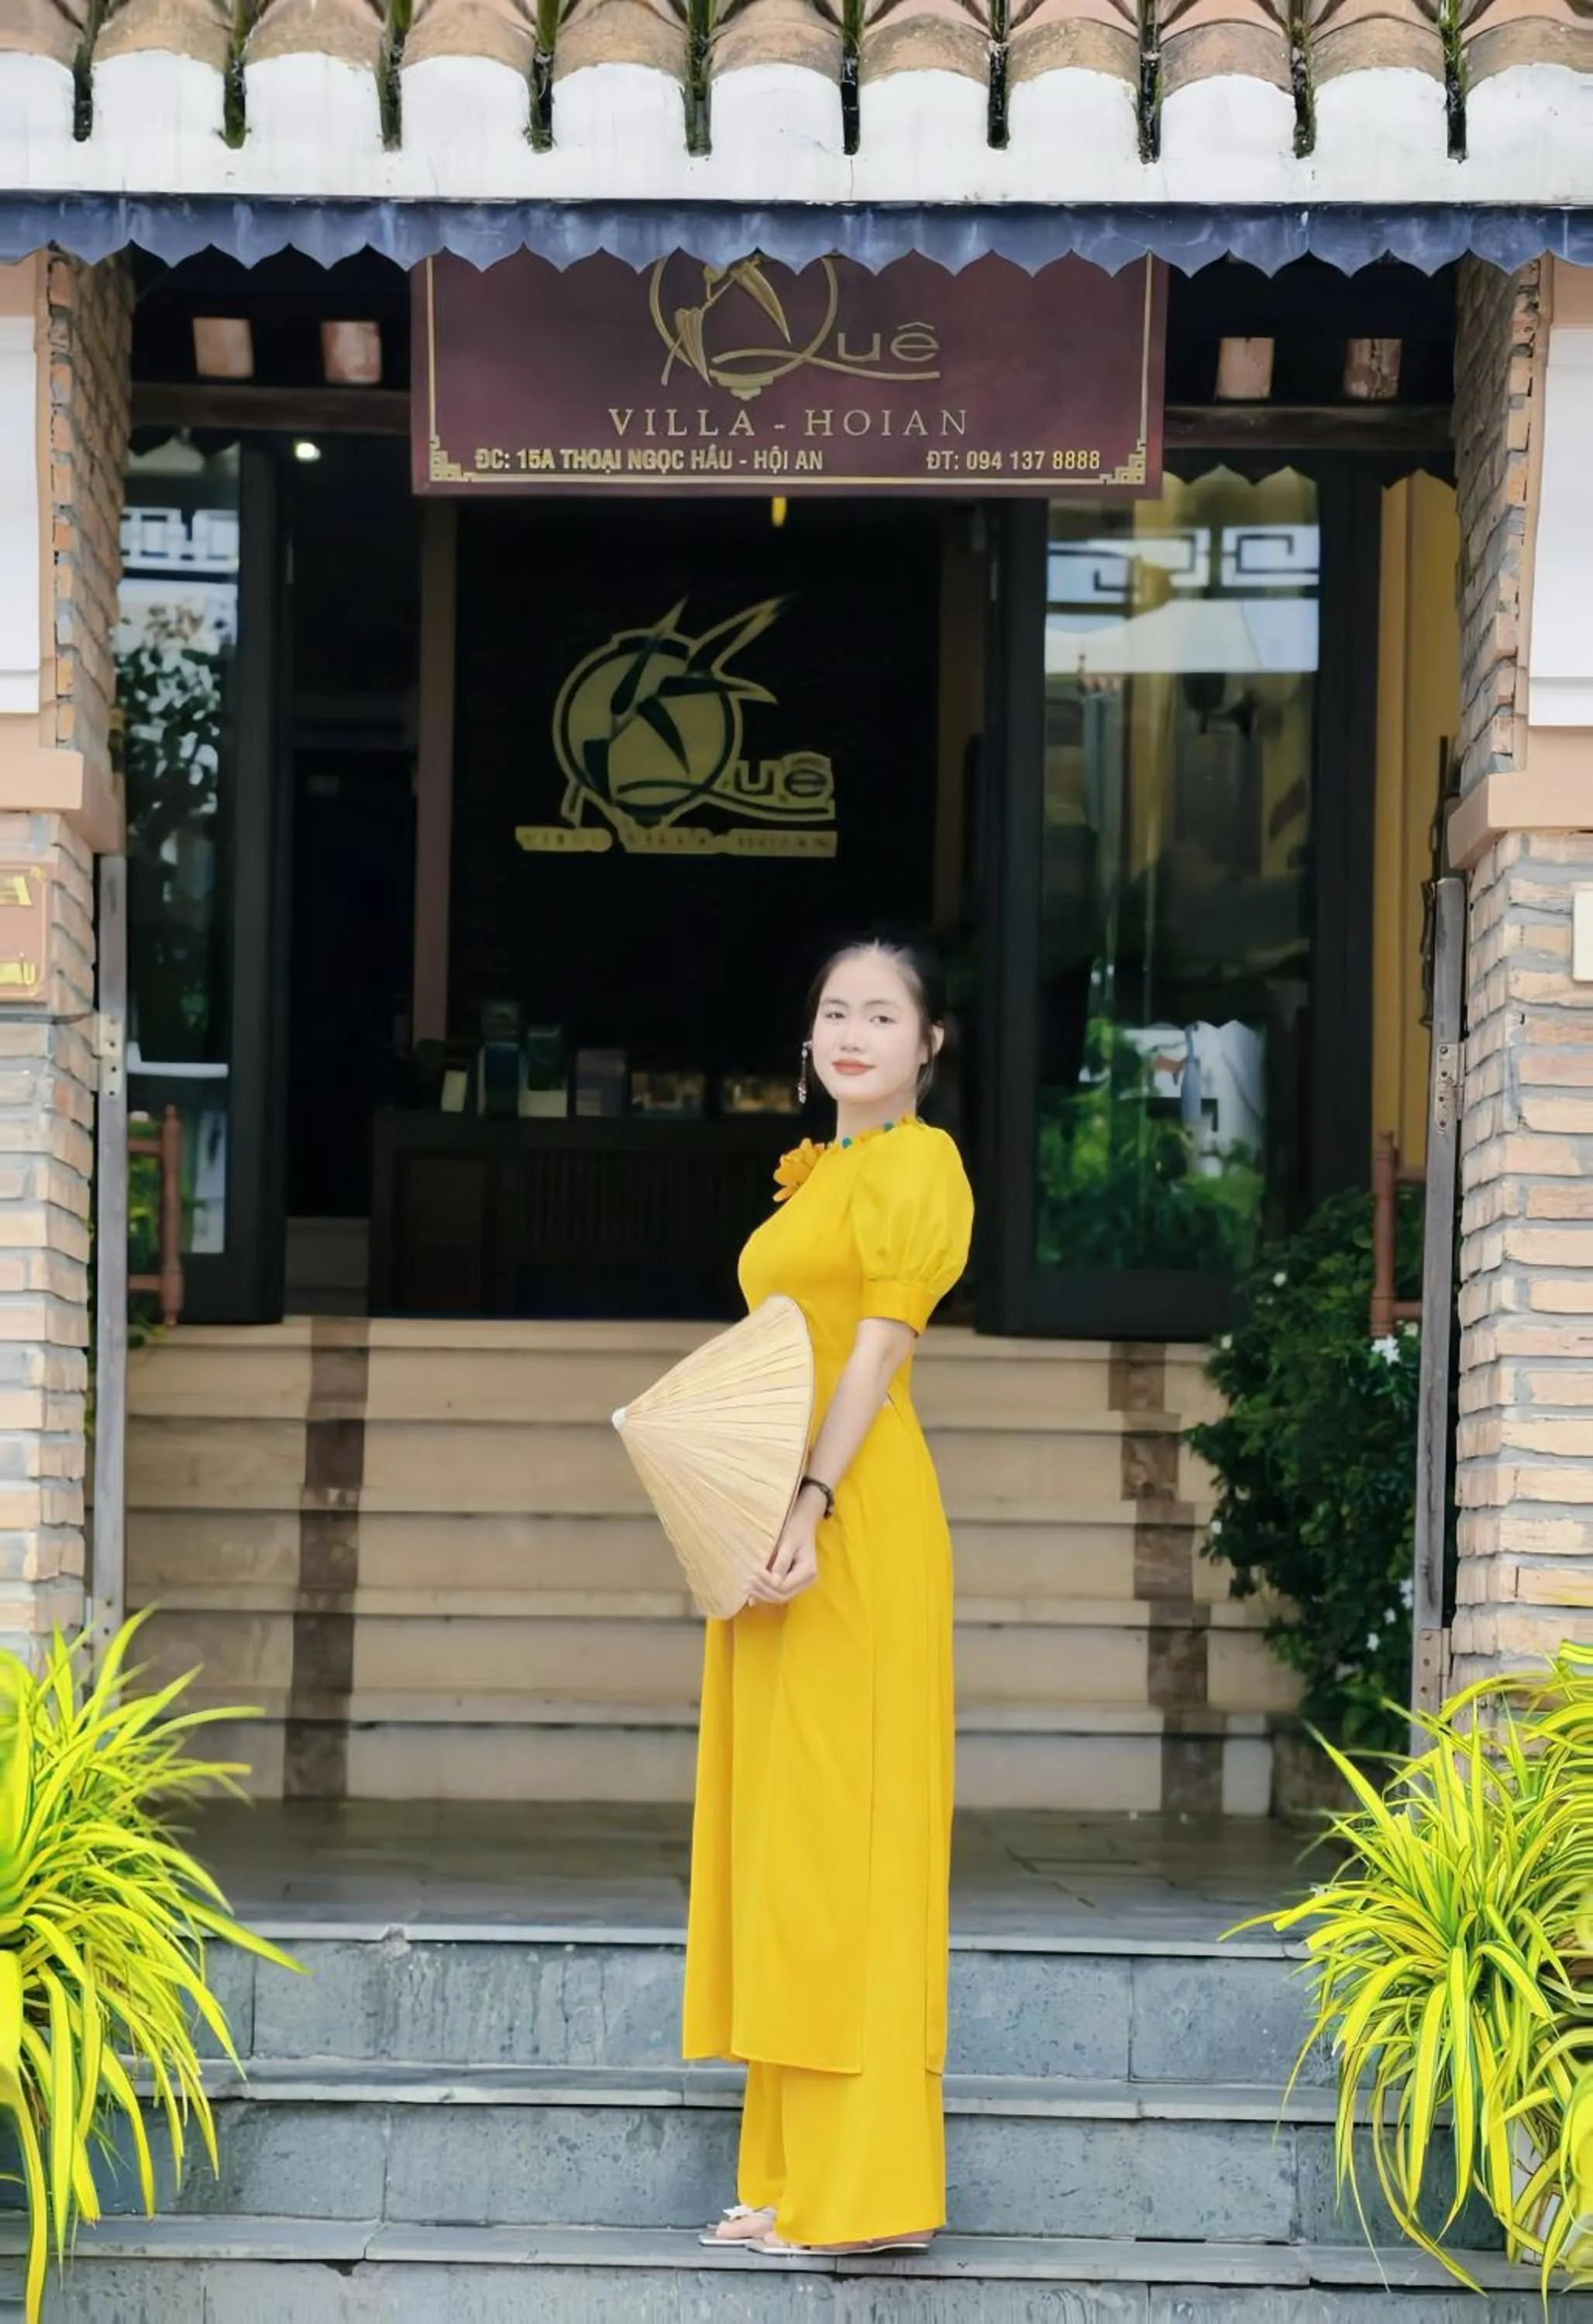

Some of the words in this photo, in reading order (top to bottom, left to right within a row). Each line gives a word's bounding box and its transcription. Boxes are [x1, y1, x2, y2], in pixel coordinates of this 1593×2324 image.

[608, 408, 755, 436] VILLA
[804, 409, 968, 436] HOIAN
[474, 447, 511, 469] ĐC:
[517, 447, 556, 469] 15A
[560, 448, 622, 474] THOẠI
[627, 449, 685, 475] NGỌC
[753, 445, 789, 475] HỘI
[794, 449, 824, 470] AN
[926, 449, 959, 470] ĐT:
[966, 450, 1003, 470] 094
[1010, 450, 1045, 470] 137
[1051, 449, 1100, 470] 8888
